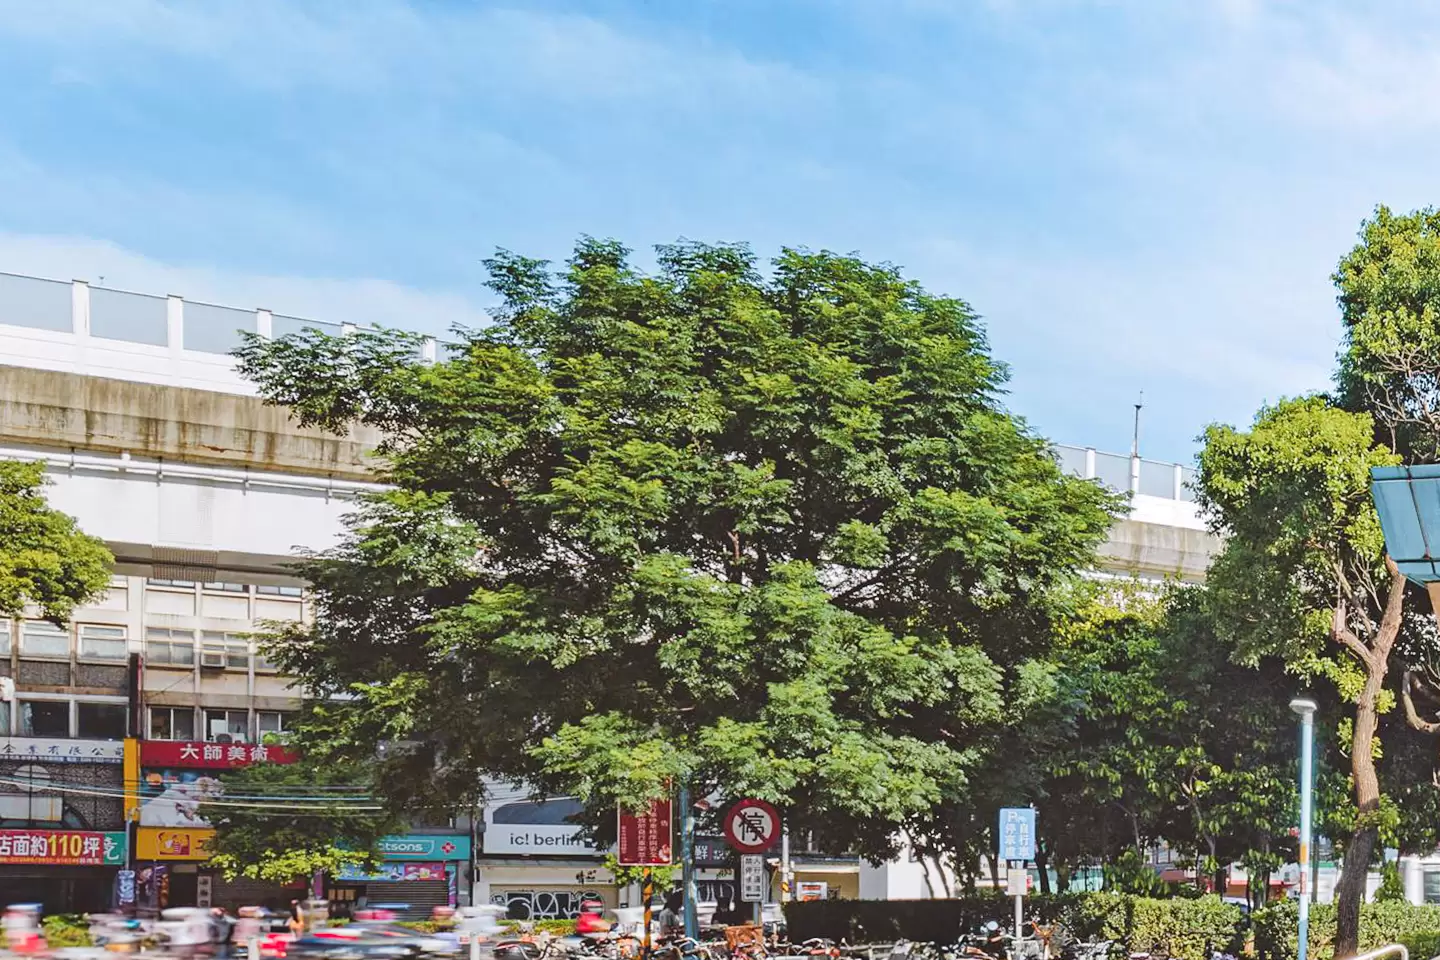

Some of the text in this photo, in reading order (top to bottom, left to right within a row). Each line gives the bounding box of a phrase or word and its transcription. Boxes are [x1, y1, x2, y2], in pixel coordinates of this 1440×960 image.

[180, 743, 268, 762] 大師美術
[739, 812, 764, 842] 停
[0, 834, 101, 858] 店面約110坪
[510, 833, 580, 847] ic! berlin
